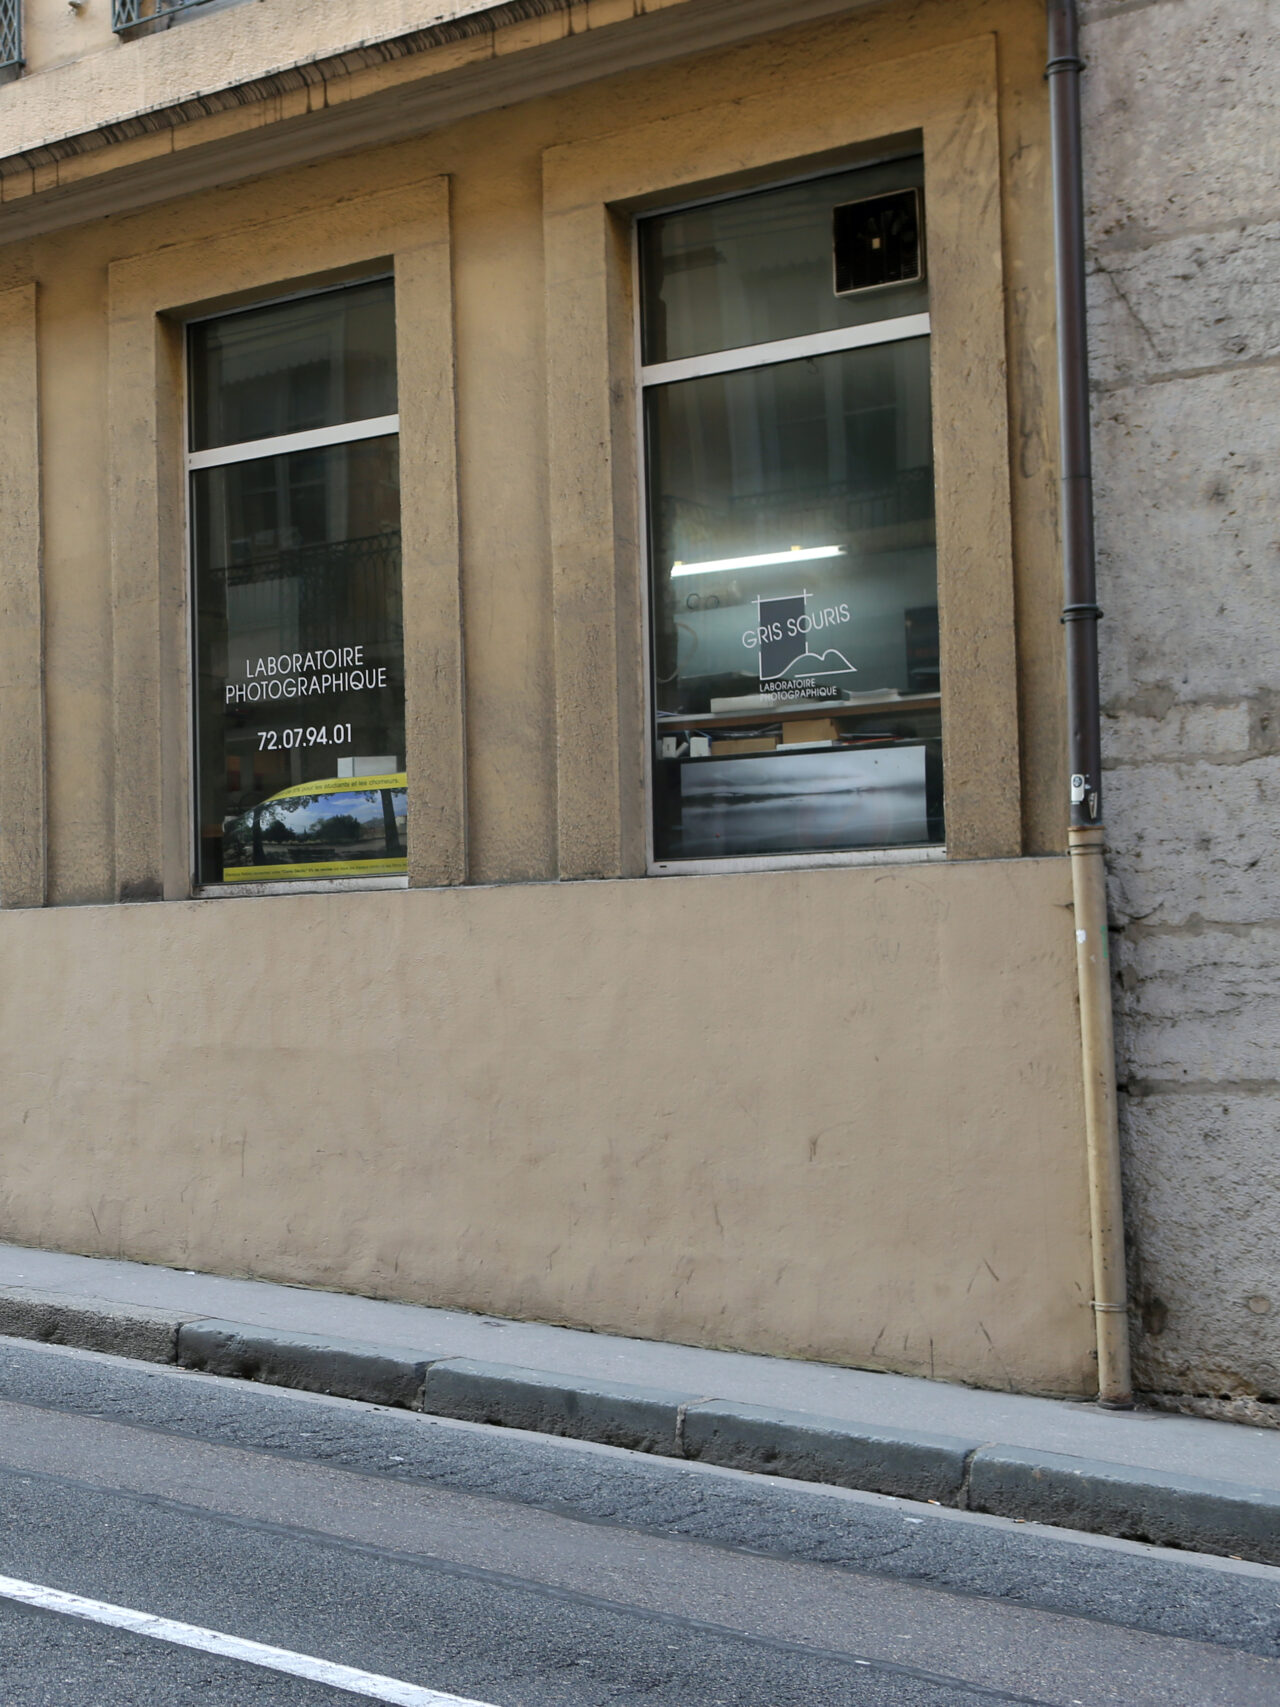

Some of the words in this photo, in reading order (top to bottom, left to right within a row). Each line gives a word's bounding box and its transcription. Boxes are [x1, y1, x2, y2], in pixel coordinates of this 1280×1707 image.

[742, 622, 783, 648] GRIS
[786, 603, 851, 637] SOURIS
[246, 645, 363, 678] LABORATOIRE
[225, 667, 387, 704] PHOTOGRAPHIQUE
[759, 678, 816, 693] LABORATOIRE
[759, 686, 838, 701] PHOTOGRAPHIQUE
[257, 723, 352, 751] 72.07.94.01
